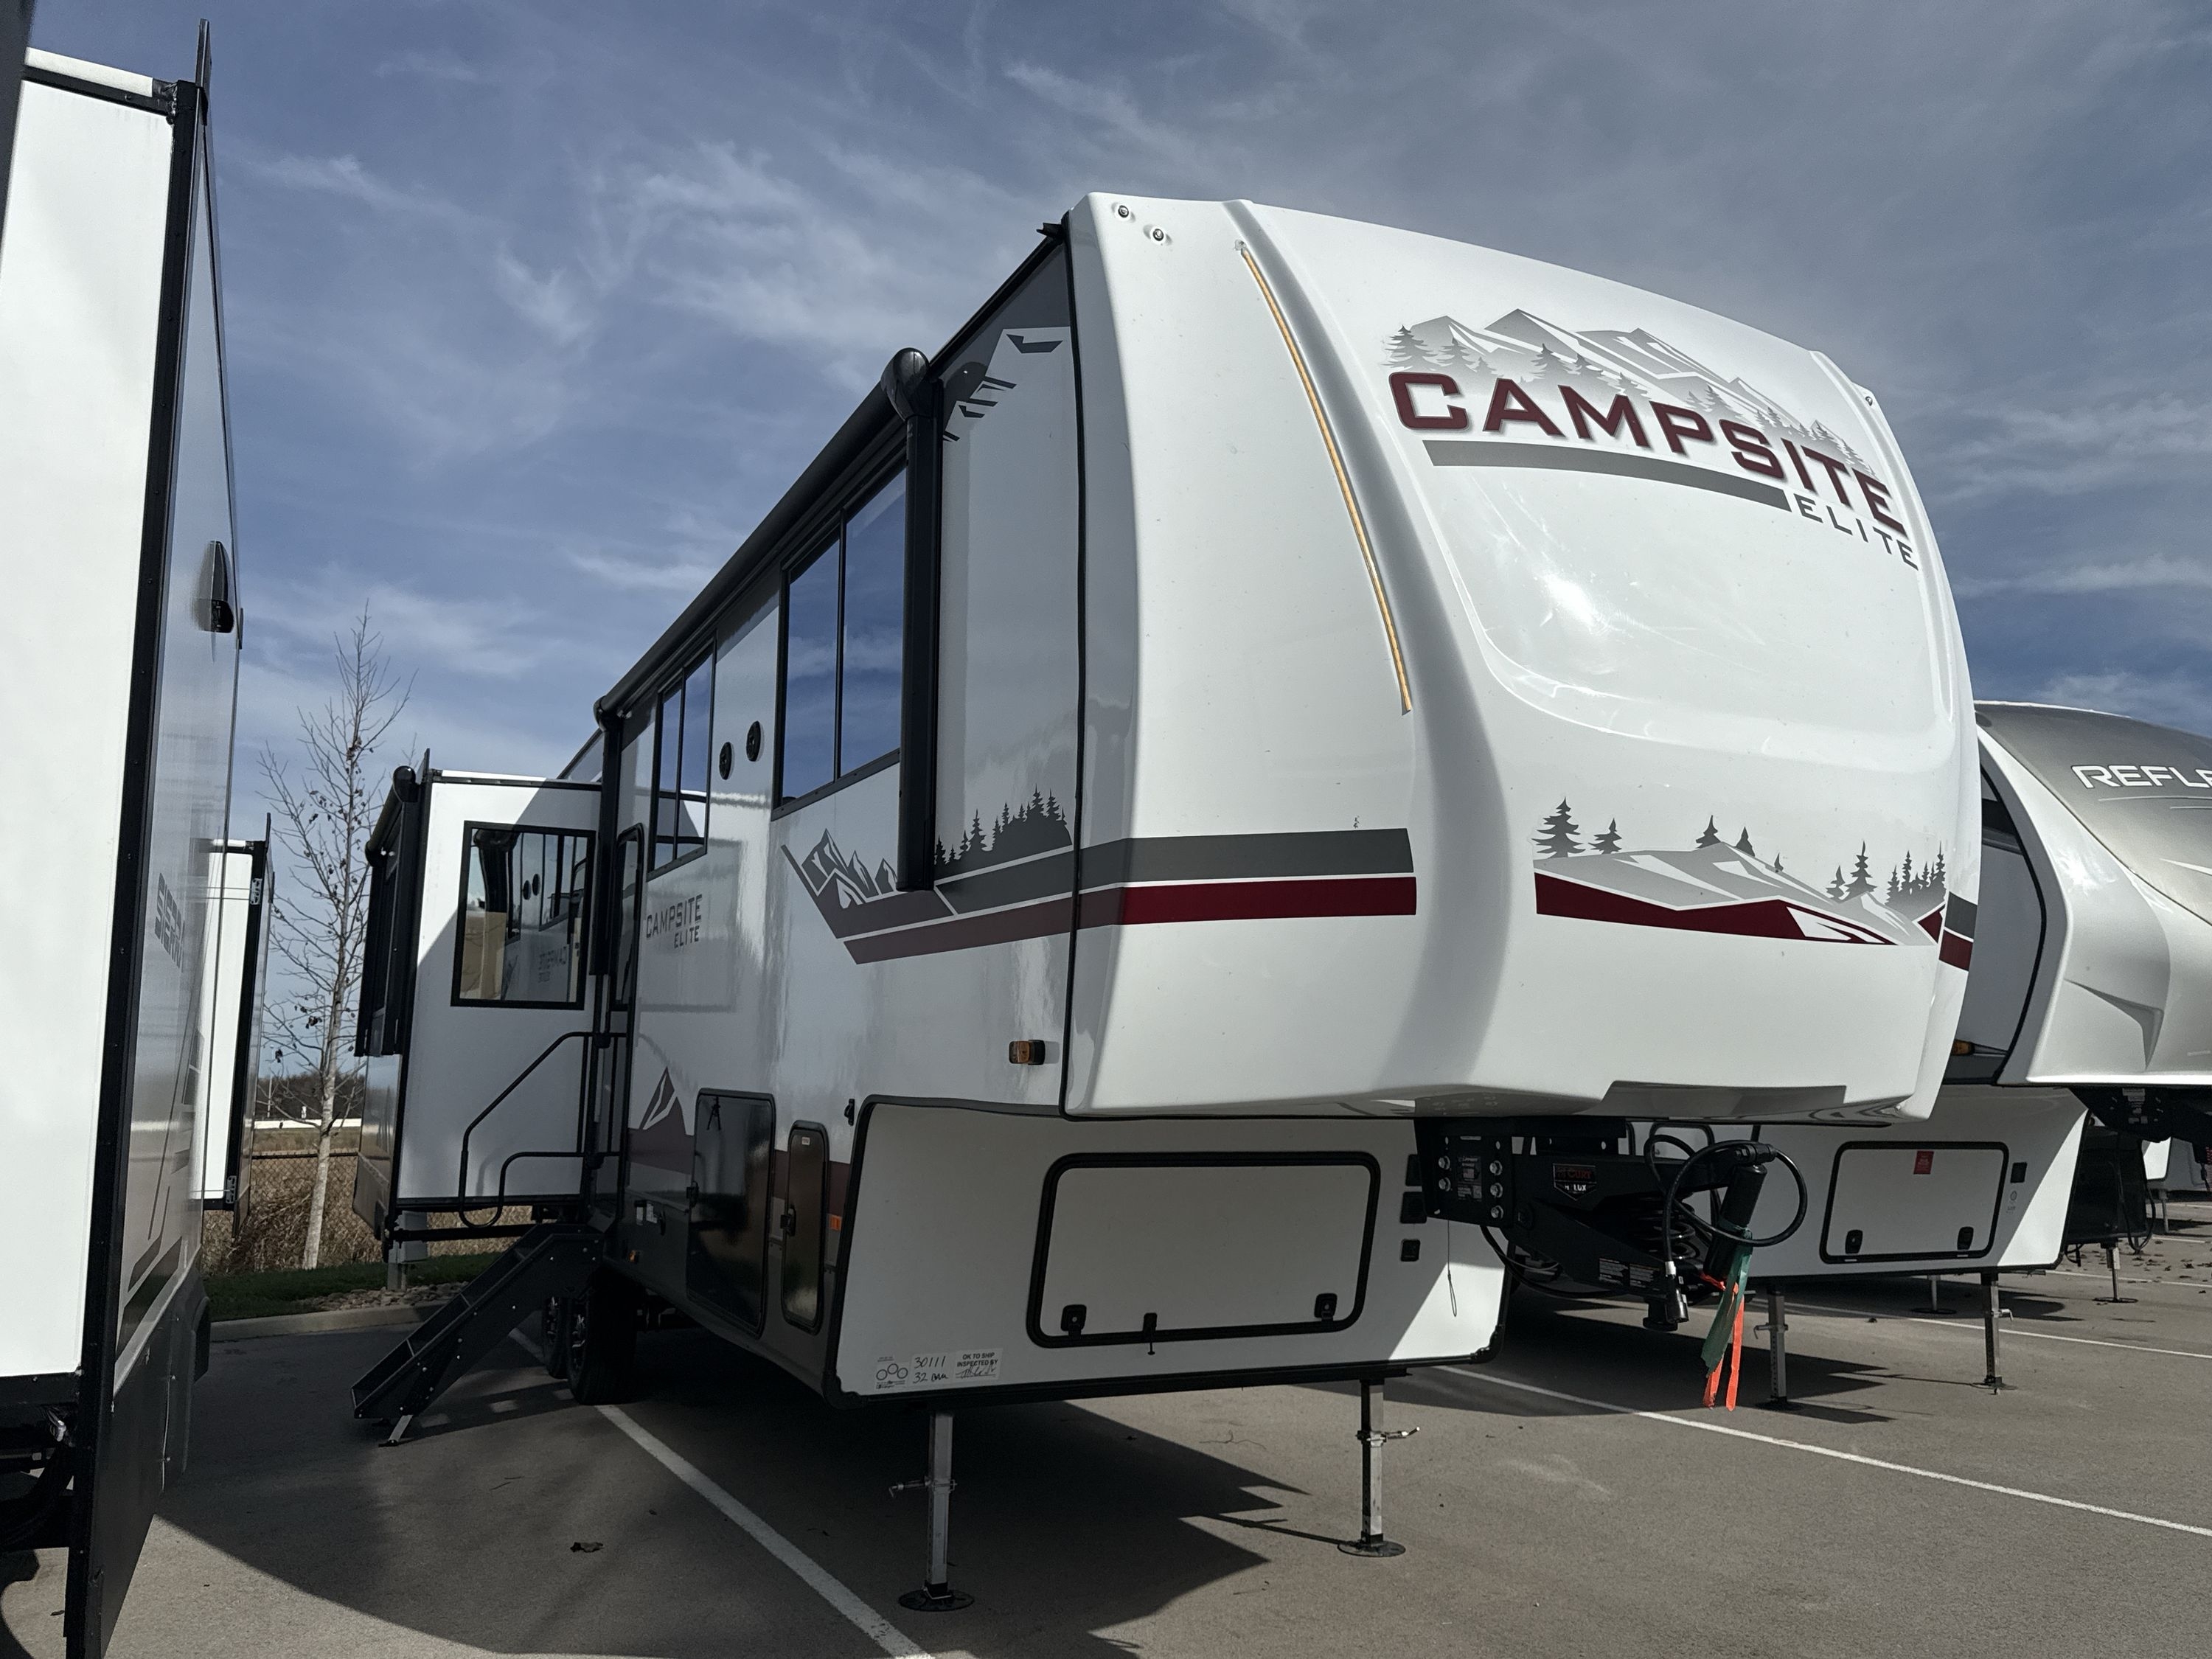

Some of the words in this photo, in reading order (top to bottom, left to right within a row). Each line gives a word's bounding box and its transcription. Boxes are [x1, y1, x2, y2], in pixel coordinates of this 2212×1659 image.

[1389, 372, 1907, 536] CAMPSITE
[1793, 493, 1919, 571] ELITE
[646, 894, 703, 939] CAMPSITE
[674, 925, 700, 949] ELITE
[1565, 1183, 1587, 1192] HLUX
[913, 1372, 928, 1384] 32
